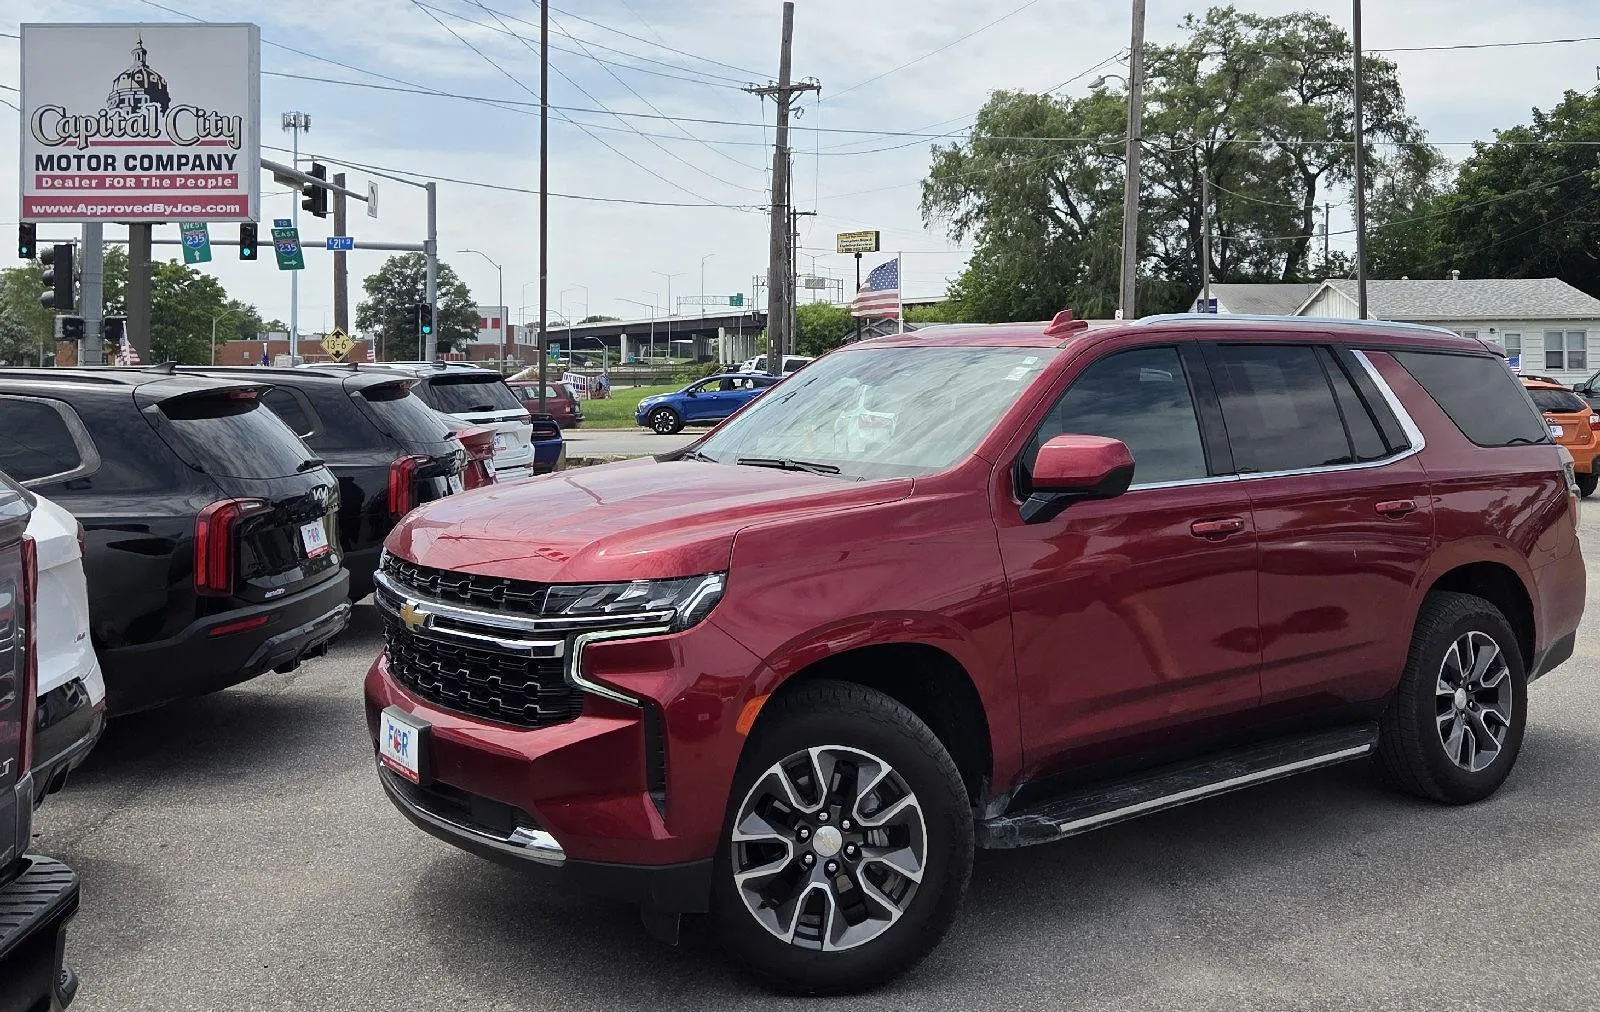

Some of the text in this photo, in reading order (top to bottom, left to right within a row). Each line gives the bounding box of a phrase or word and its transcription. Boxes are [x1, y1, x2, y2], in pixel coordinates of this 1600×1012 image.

[31, 103, 242, 150] Capital City
[35, 153, 238, 171] MOTOR COMPANY
[42, 176, 232, 189] Dealer FOR The People
[32, 203, 240, 215] www.ApprovedByJoe.com
[186, 234, 205, 244] 235
[274, 230, 295, 238] EAST
[279, 243, 297, 252] 235
